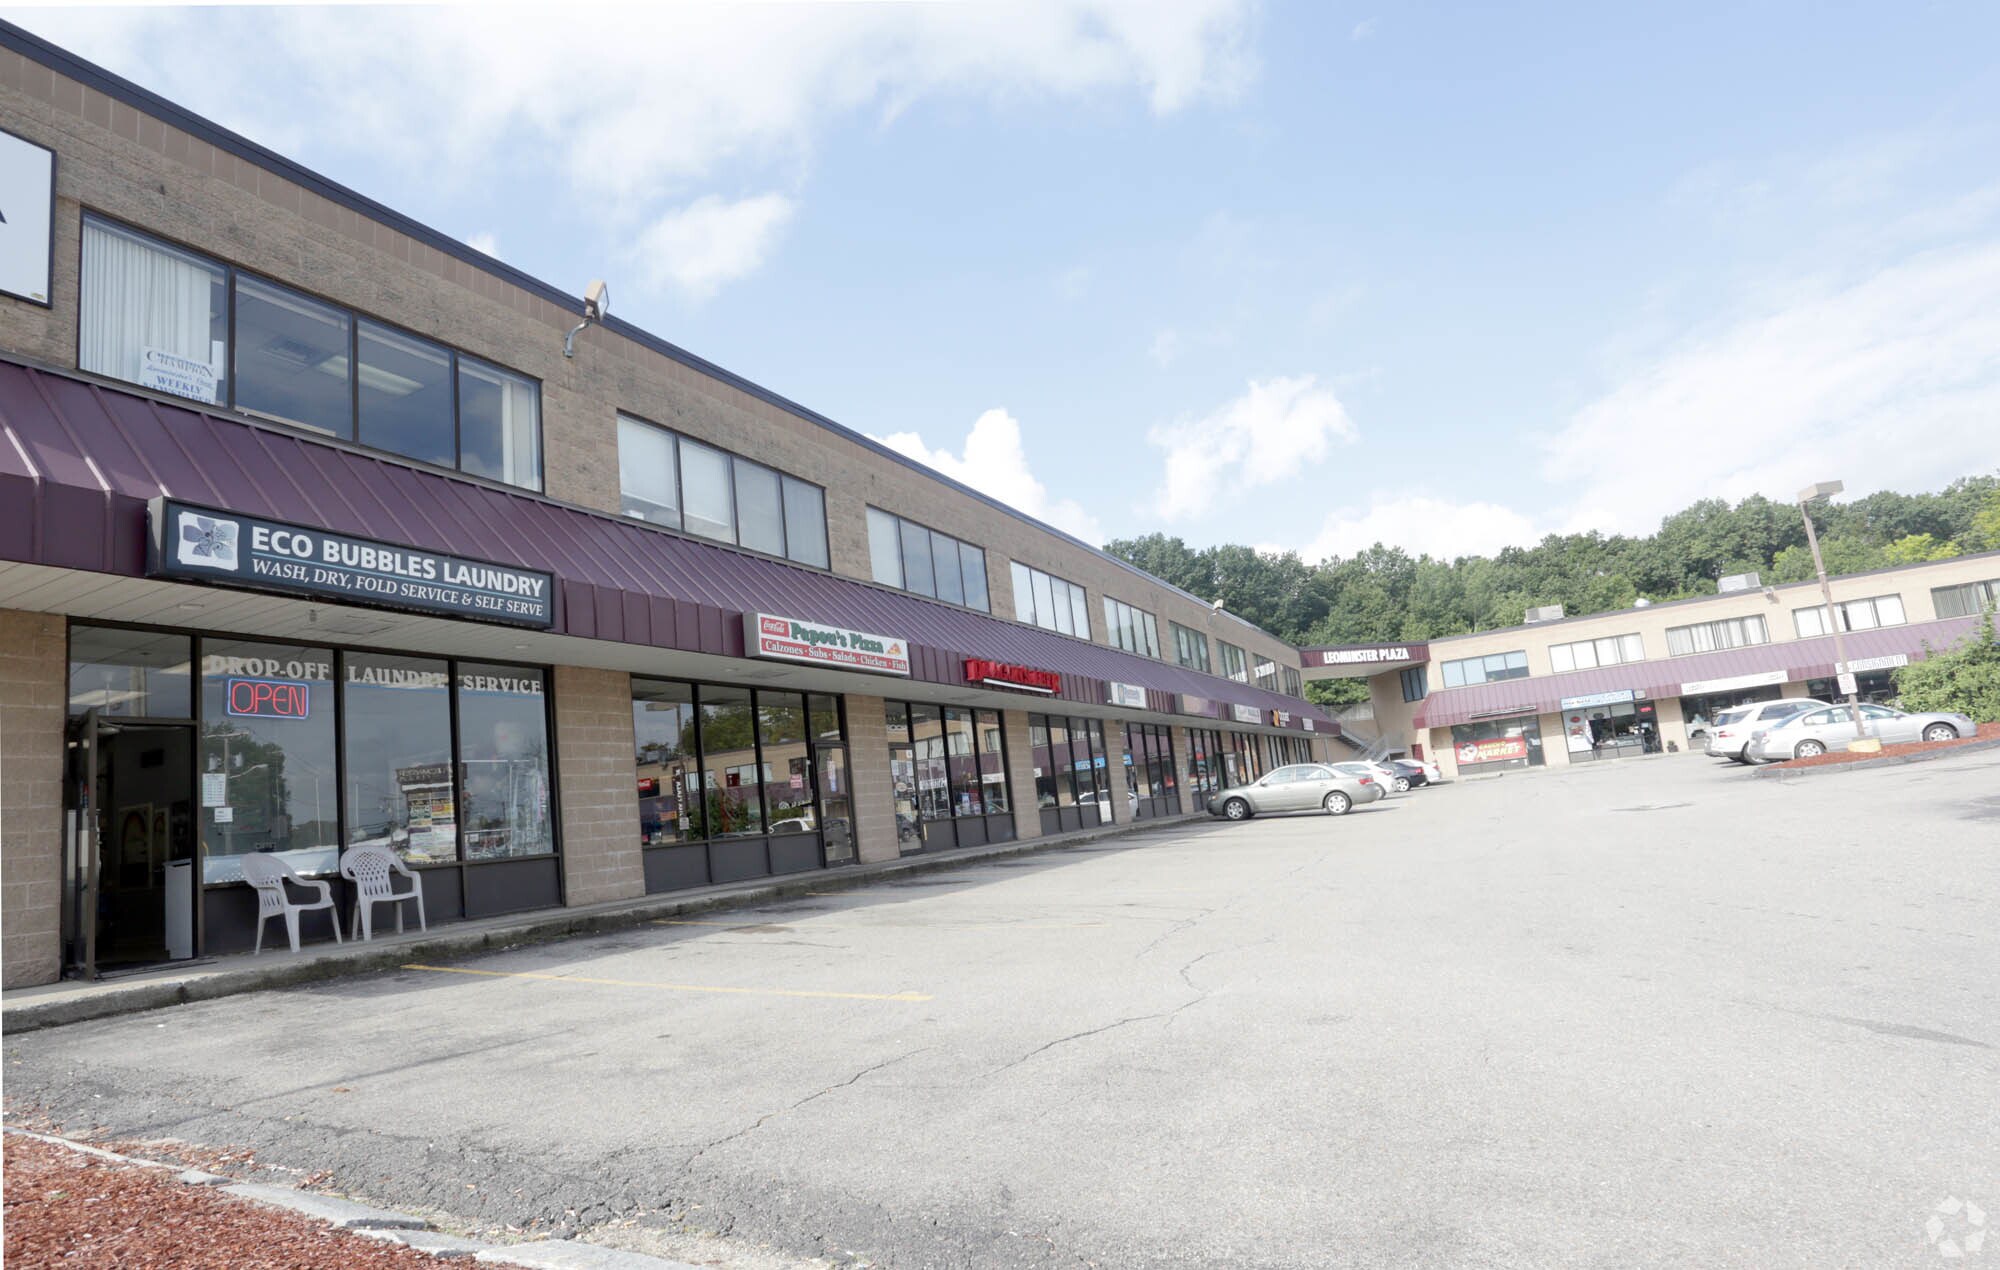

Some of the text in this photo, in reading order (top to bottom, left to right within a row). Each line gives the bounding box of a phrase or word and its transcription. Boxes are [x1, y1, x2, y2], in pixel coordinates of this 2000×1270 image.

[156, 376, 203, 395] WEEKLY
[252, 526, 544, 597] ECO BUBBLES LAUNDRY
[252, 558, 544, 617] WASH, DRY, FOLD SERVICE & SELF SERVE
[765, 641, 906, 671] Calzones Subs Salads Chicken Fish
[848, 632, 884, 654] Pizza
[1323, 647, 1410, 664] LEOMINSTER PLAZA
[208, 655, 541, 695] DROP-OFF LAUNDRY SERVICE
[231, 682, 306, 716] OPEN
[1476, 744, 1521, 761] MARKET
